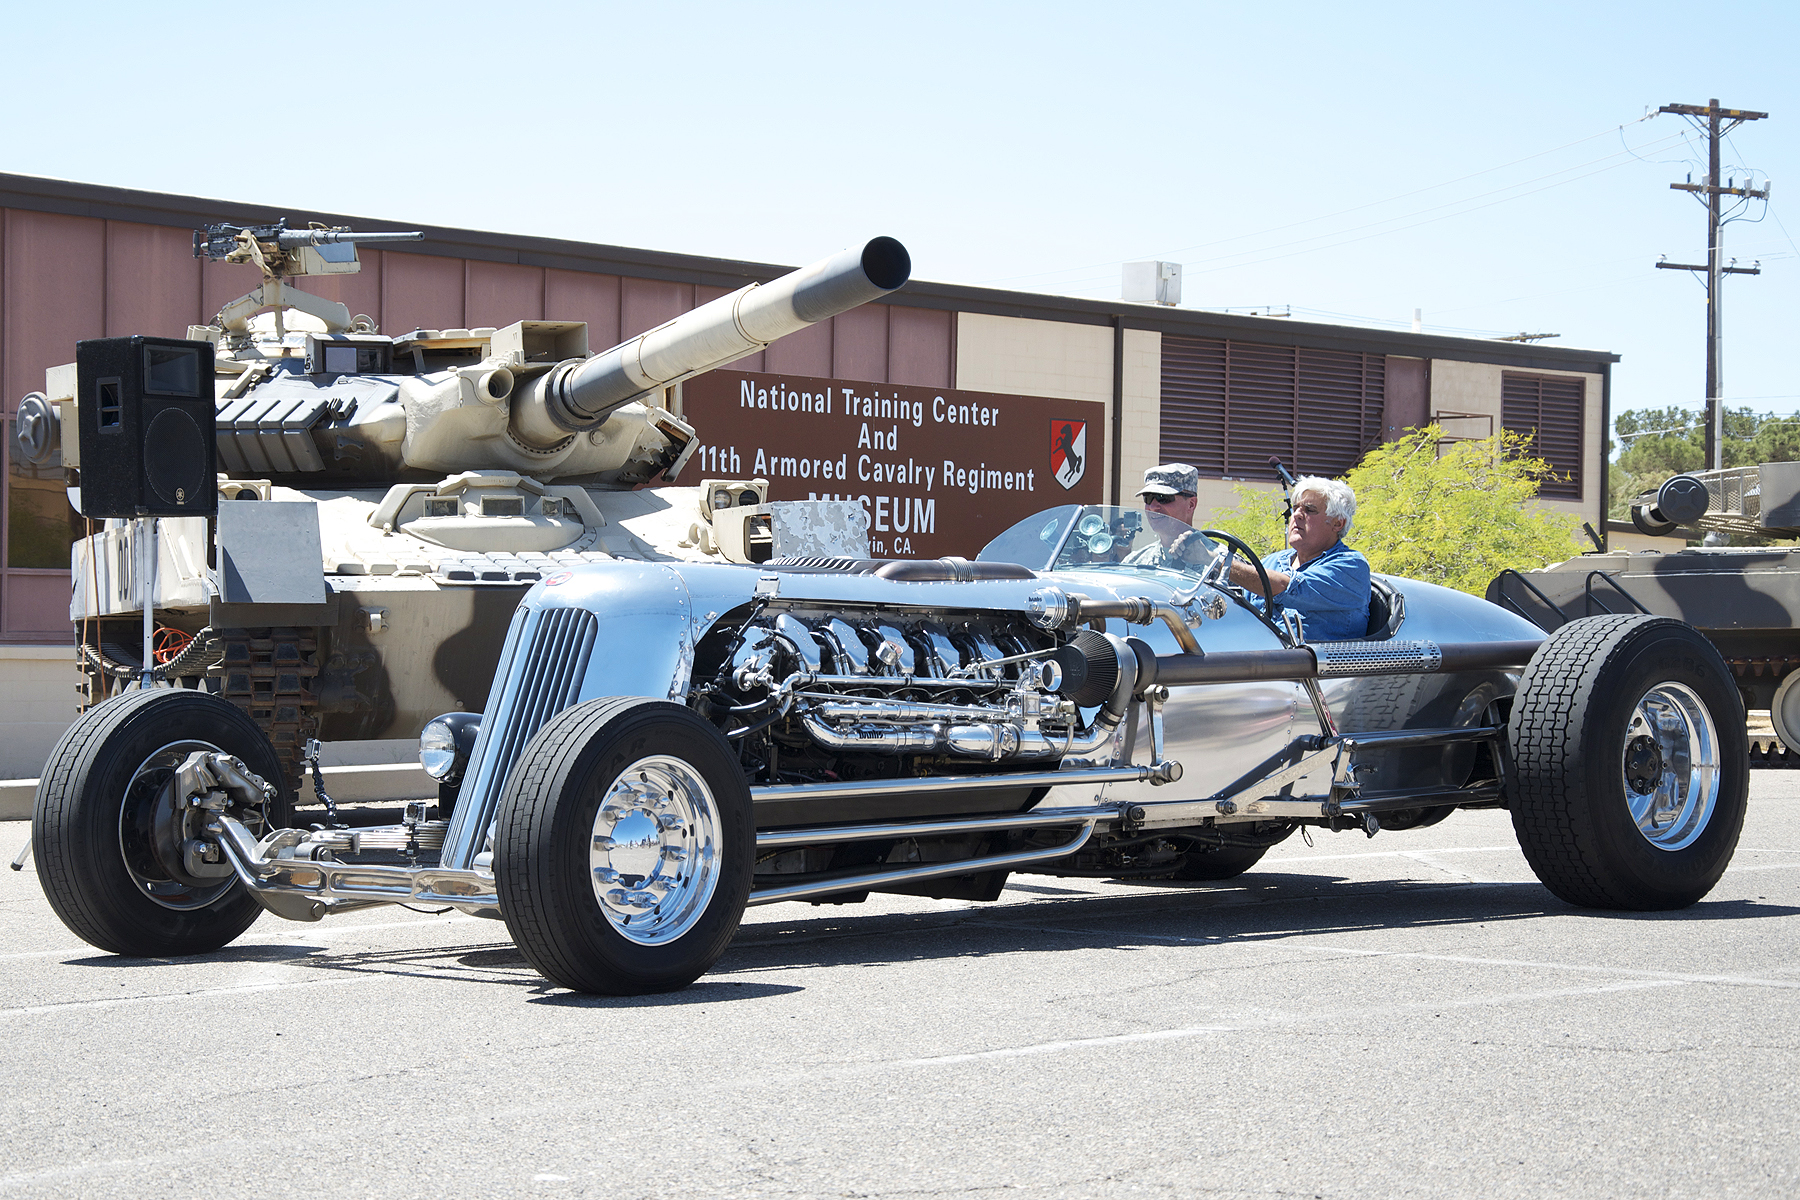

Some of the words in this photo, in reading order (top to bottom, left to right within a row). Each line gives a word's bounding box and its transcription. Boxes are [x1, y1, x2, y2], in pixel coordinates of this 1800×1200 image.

[740, 379, 832, 414] National
[841, 388, 923, 427] Training
[932, 396, 999, 427] Center
[857, 422, 898, 451] And
[698, 444, 741, 474] 11th
[752, 448, 847, 480] Armored
[857, 454, 936, 492] Cavalry
[943, 460, 1035, 494] Regiment
[808, 492, 936, 534] SEUM
[867, 536, 888, 556] in,
[893, 536, 916, 555] CA.
